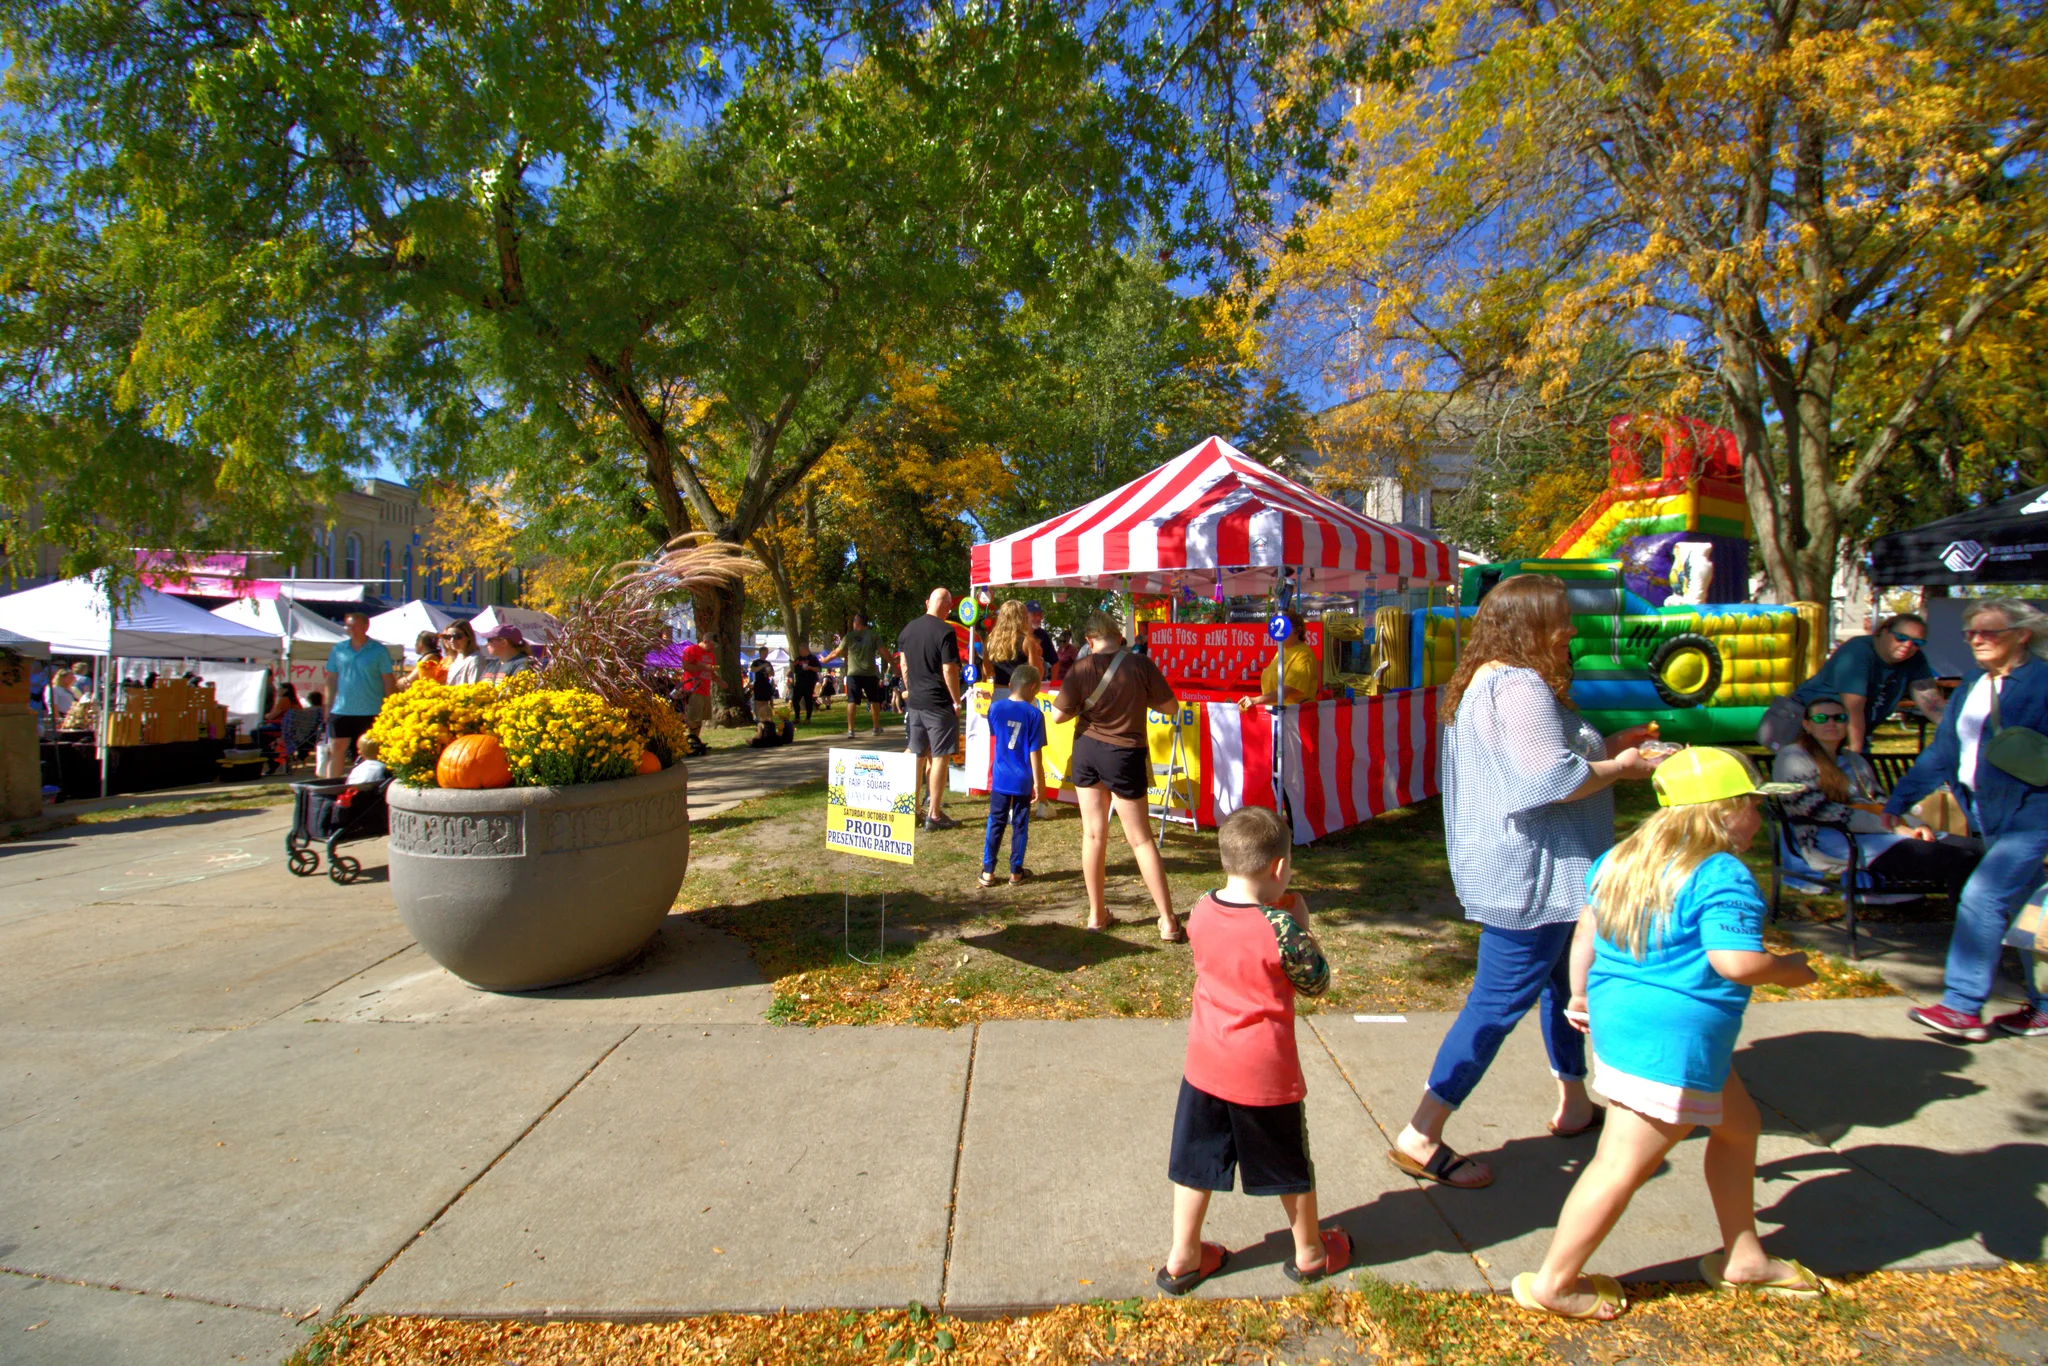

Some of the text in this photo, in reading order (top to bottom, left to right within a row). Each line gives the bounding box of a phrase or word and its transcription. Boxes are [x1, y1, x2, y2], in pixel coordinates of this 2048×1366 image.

[1151, 628, 1198, 645] RING TOSS
[1270, 618, 1285, 638] $2
[1205, 628, 1255, 646] RING TOSS
[964, 666, 974, 681] $2
[1181, 692, 1210, 700] Baraboo
[1148, 709, 1194, 725] CLUB
[1006, 720, 1023, 750] 7
[866, 779, 891, 791] SQUARE
[867, 811, 888, 822] OCTOBER
[846, 819, 892, 838] PROUD
[828, 830, 912, 856] PRESENTING PARTNER
